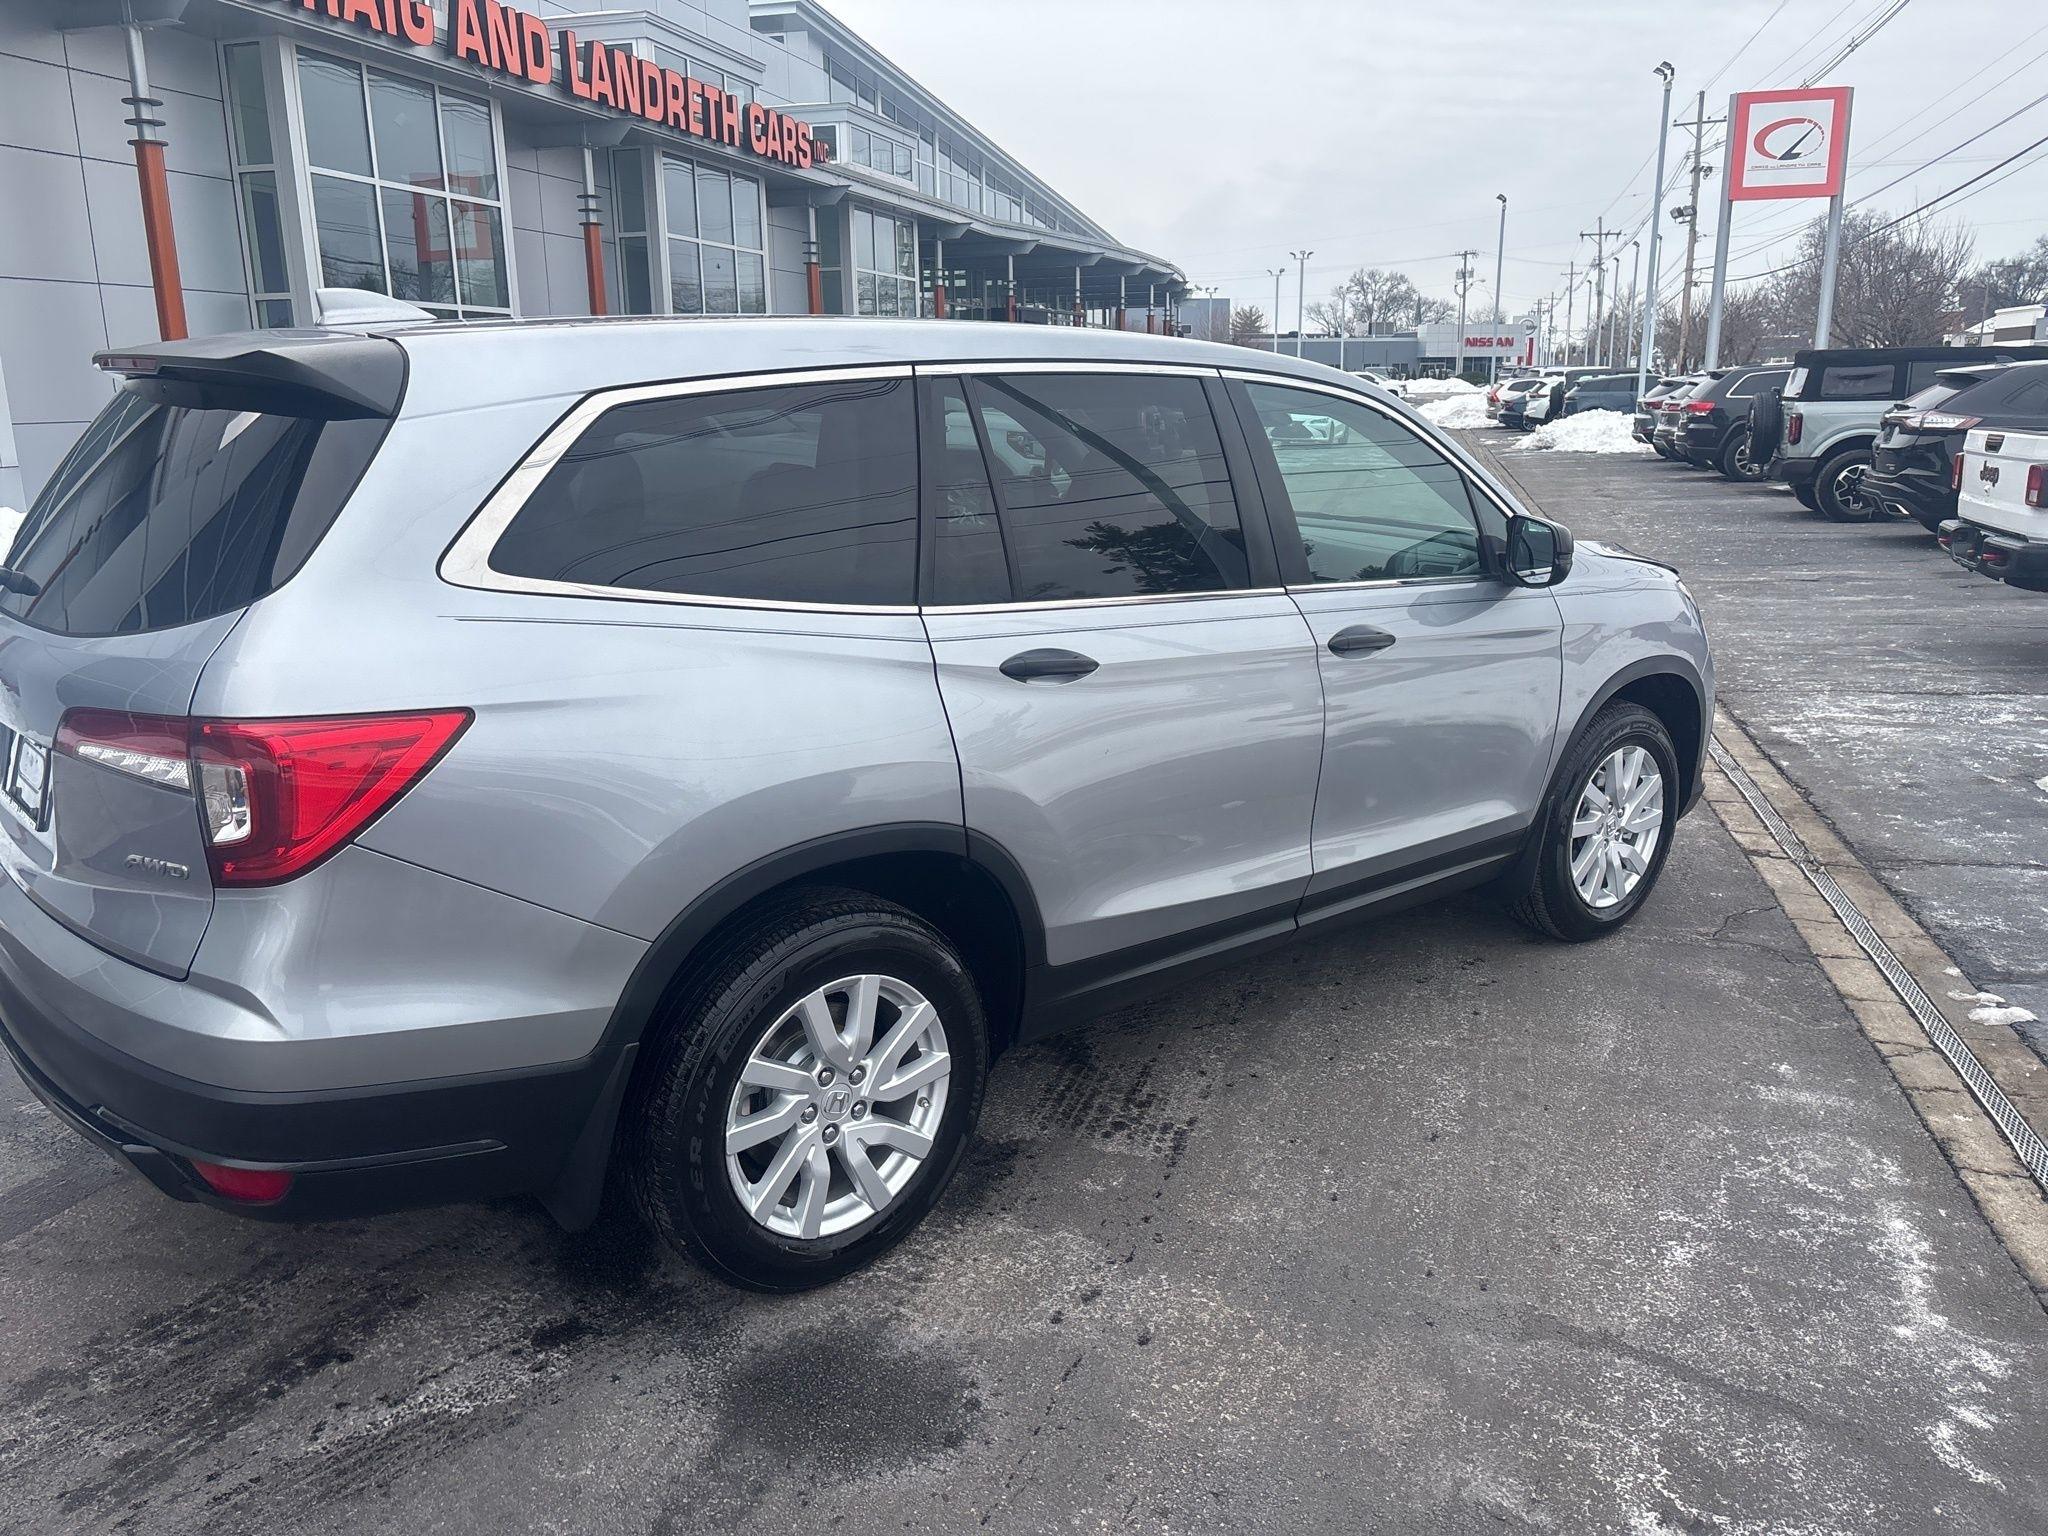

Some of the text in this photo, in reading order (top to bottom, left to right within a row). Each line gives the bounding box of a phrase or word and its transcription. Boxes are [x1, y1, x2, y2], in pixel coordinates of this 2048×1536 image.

[456, 0, 552, 84] AND
[565, 30, 741, 147] LANDRETH
[748, 102, 812, 169] CARS
[1465, 337, 1514, 347] NISSAN
[125, 854, 190, 880] AWD
